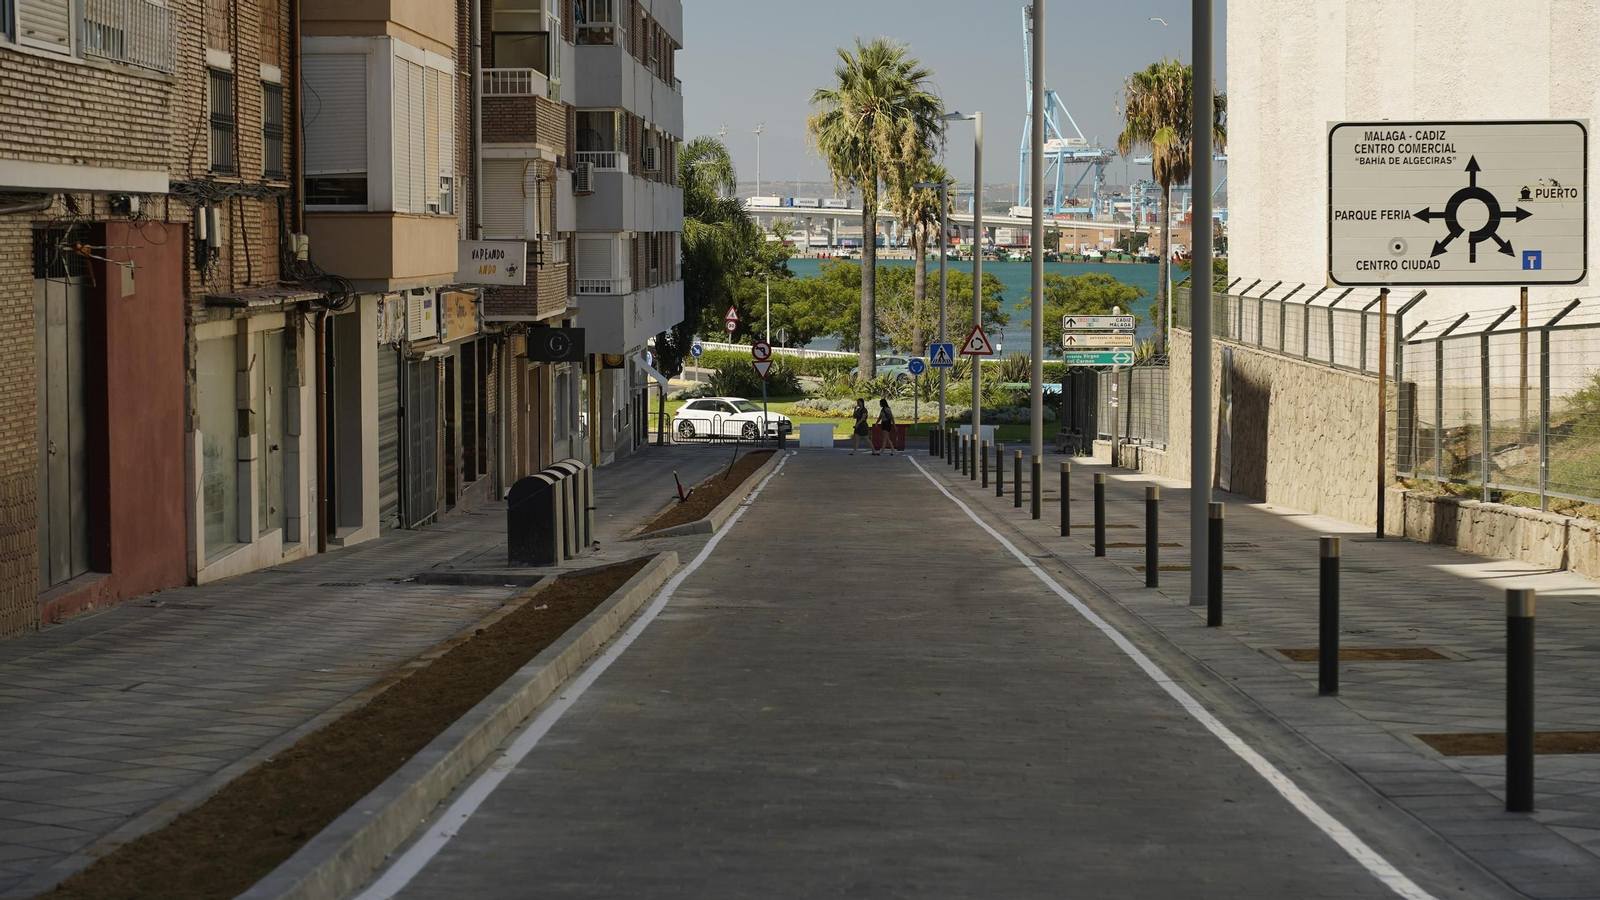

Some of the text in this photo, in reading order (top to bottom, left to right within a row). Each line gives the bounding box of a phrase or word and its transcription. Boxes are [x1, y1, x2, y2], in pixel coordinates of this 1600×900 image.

[1364, 130, 1406, 141] MALAGA
[1415, 130, 1446, 141] CADIZ
[1354, 143, 1457, 154] CENTRO COMERCIAL
[1388, 156, 1400, 165] DE
[1535, 188, 1578, 199] PUERTO
[1334, 209, 1411, 221] PARQUE FERIA
[471, 248, 505, 260] VAPEANDO
[478, 264, 497, 275] ANDO
[1356, 259, 1440, 271] CENTRO CIUDAD
[549, 336, 563, 352] G
